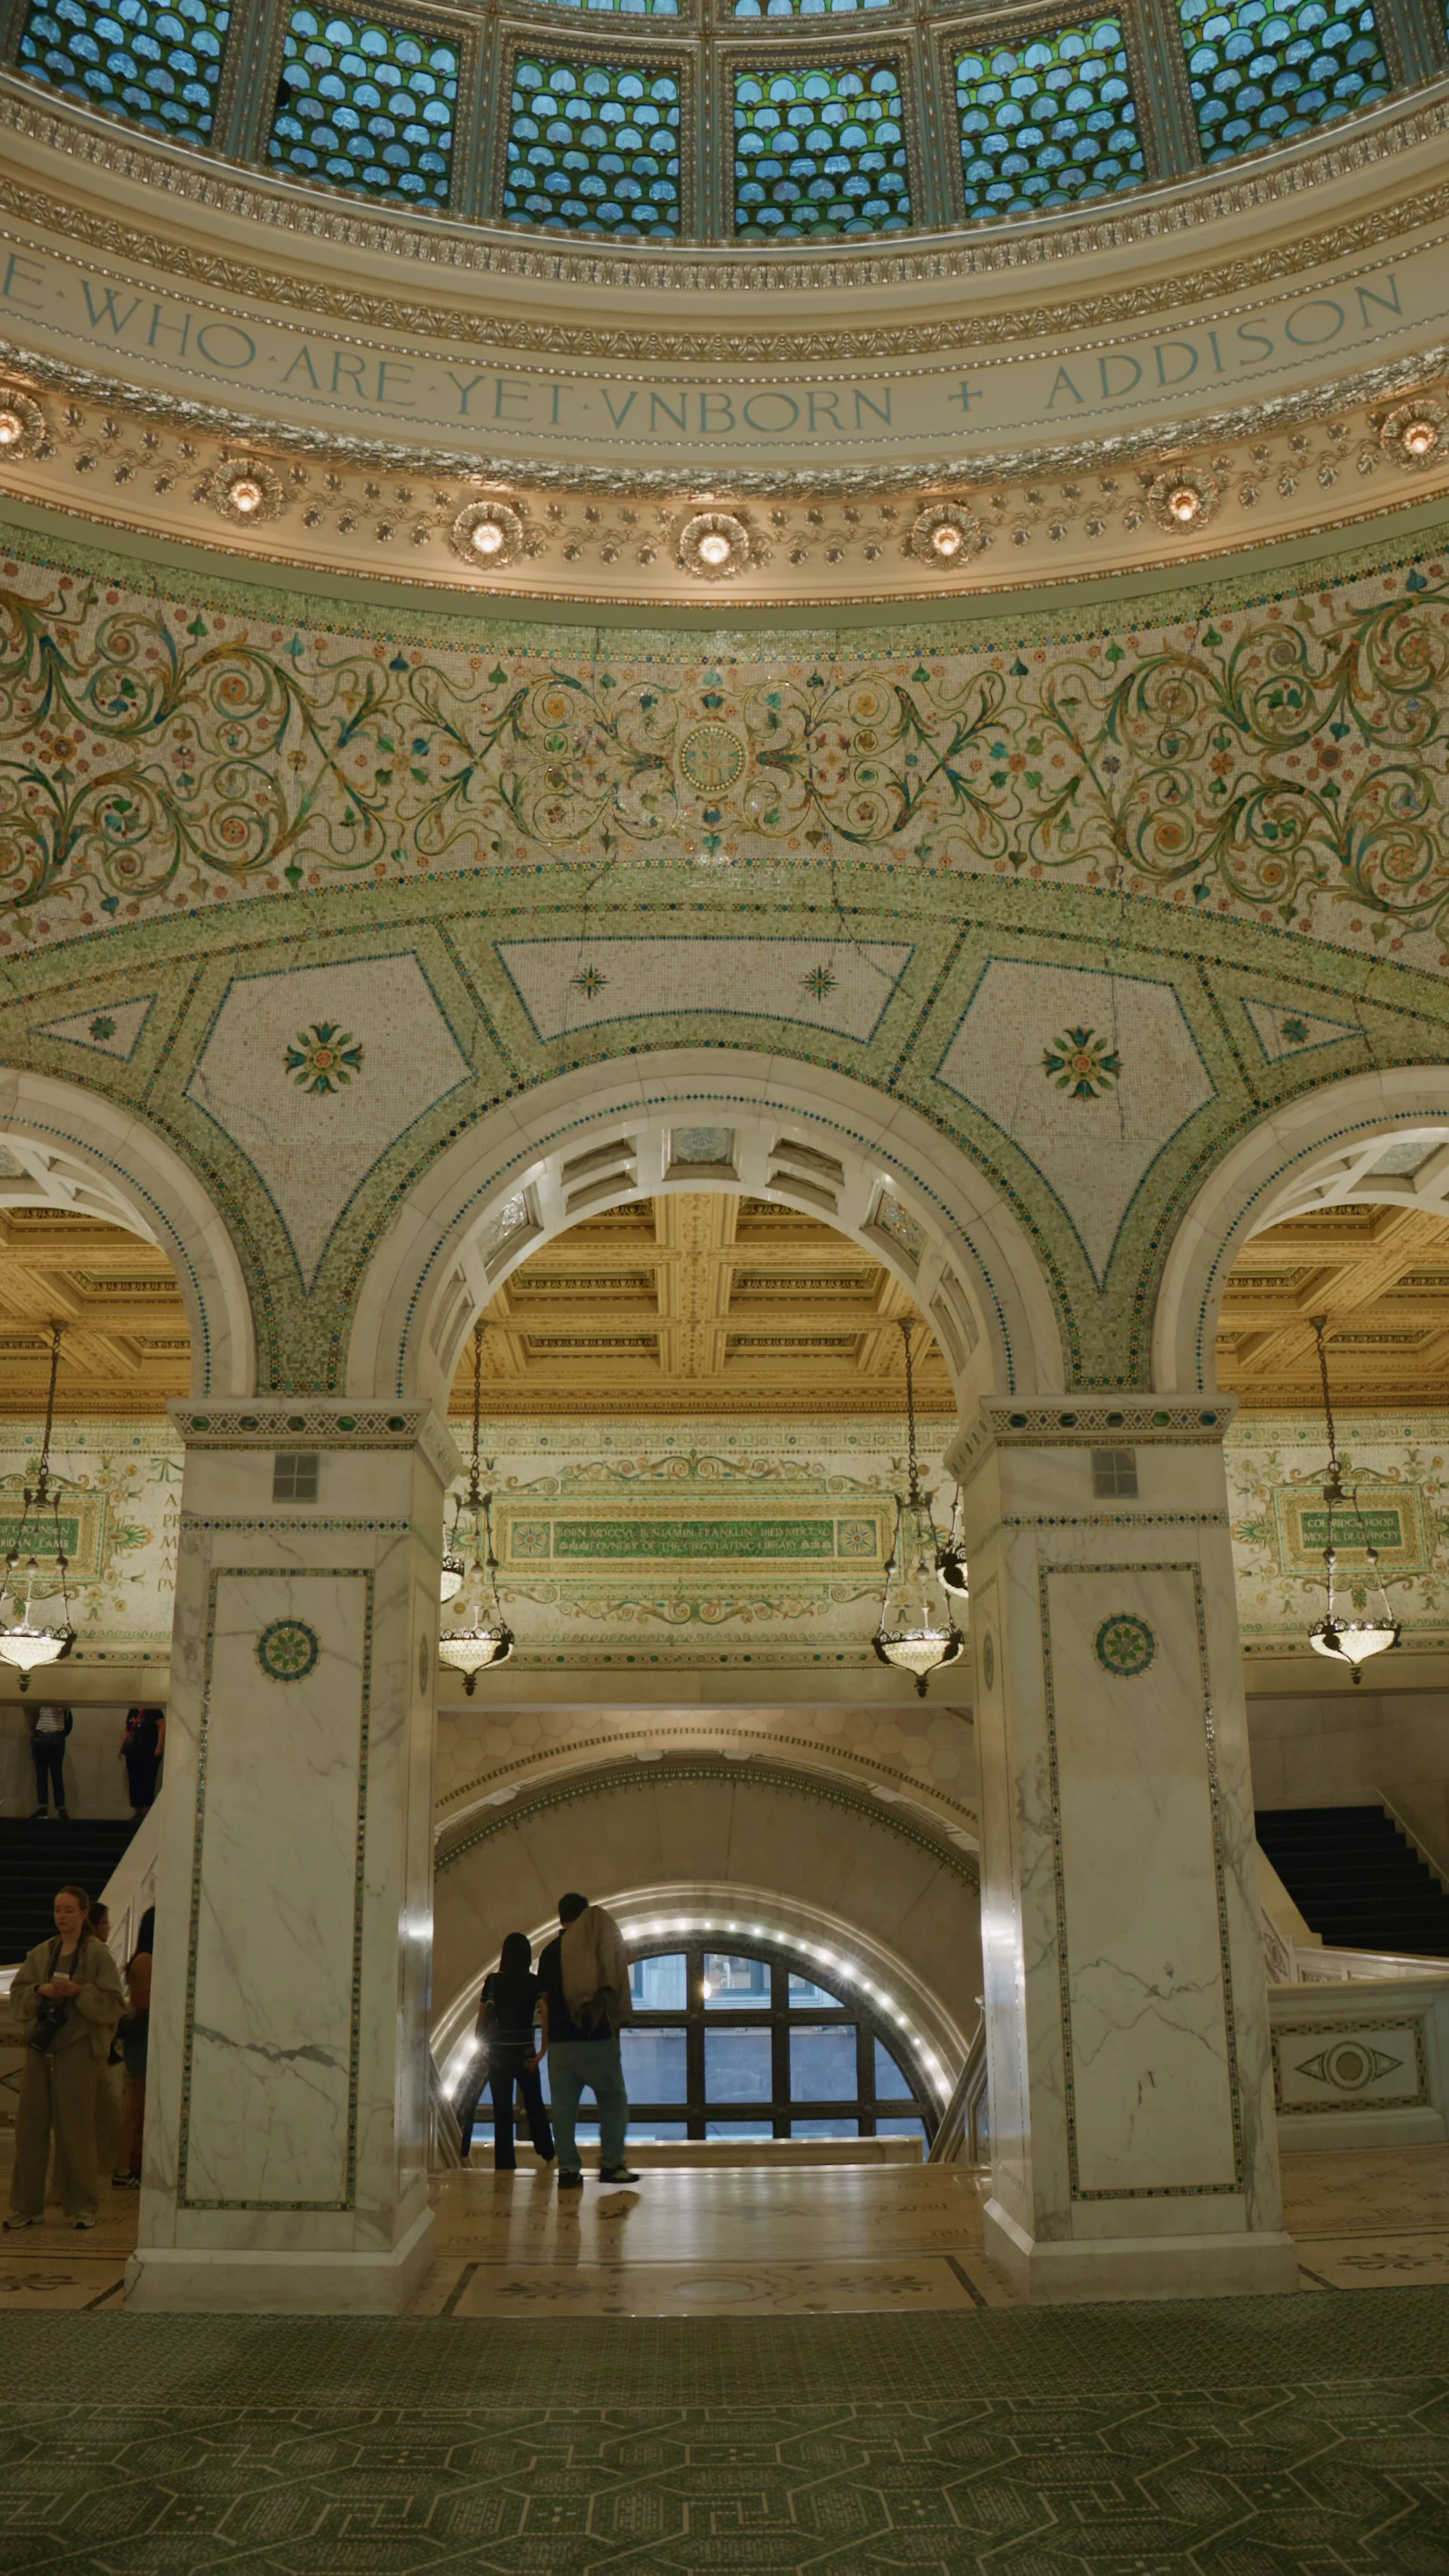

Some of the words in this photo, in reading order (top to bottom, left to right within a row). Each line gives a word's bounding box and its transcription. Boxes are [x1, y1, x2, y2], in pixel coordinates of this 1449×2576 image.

[79, 279, 256, 368] WHO
[281, 346, 415, 407] ARE
[443, 371, 576, 426] YET
[600, 387, 894, 433] VNBORN
[1045, 273, 1403, 410] ADDISON
[1307, 1517, 1363, 1528] COLRIDG
[1365, 1517, 1394, 1527] HOOD
[0, 1525, 17, 1534] IFT
[558, 1527, 586, 1537] BORN
[589, 1527, 632, 1537] MDCCVI
[640, 1527, 694, 1537] BENJAMIN
[698, 1527, 753, 1537] FRANKLIN
[760, 1527, 783, 1537] DIED
[39, 1540, 69, 1549] LAMB
[642, 1541, 655, 1550] OF
[660, 1541, 680, 1550] THE
[758, 1540, 797, 1550] LIBRARY
